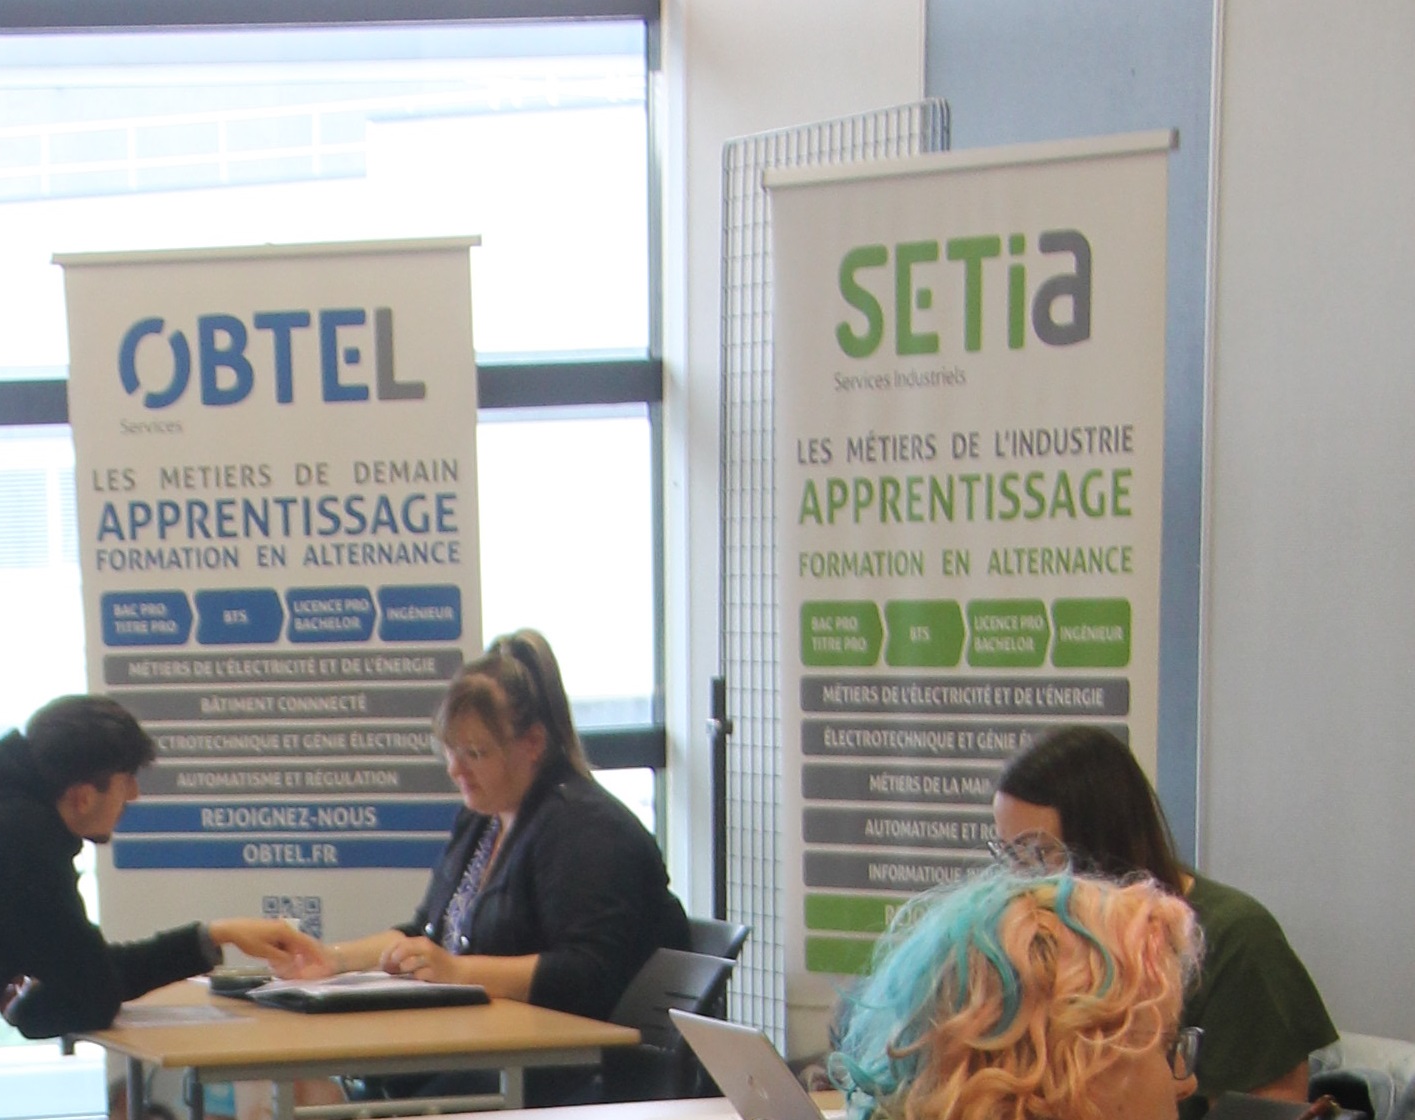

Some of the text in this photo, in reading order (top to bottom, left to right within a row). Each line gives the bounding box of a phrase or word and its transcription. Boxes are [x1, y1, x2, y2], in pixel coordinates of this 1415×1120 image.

[835, 228, 1092, 359] SETia
[118, 306, 427, 410] OBTEL
[834, 366, 967, 391] Services Industriels
[120, 418, 184, 436] Services
[797, 424, 1135, 466] LES MÉTIERS DE L'INDUSTRIE
[92, 468, 137, 493] LES
[295, 461, 330, 486] DE
[353, 457, 460, 485] DEMAIN
[797, 467, 1134, 526] APPRENTISSAGE
[96, 492, 460, 542] APPRENTISSAGE
[96, 539, 462, 572] FORMATION EN ALTERNANCE
[798, 545, 1134, 578] FORMATION EN ALTERNANCE
[140, 602, 168, 618] PRO
[293, 598, 370, 614] LICENCE PRO
[388, 605, 454, 621] INGÉNIEUR
[150, 619, 178, 634] PRO
[223, 610, 248, 624] BTS
[294, 616, 361, 631] BACHELOR
[811, 616, 859, 632] BAC PRO
[974, 614, 1044, 632] LICENCE PRO
[909, 626, 931, 642] BTS
[974, 635, 1035, 653] BACHELOR
[1060, 624, 1125, 643] INGÉNIEUR
[811, 636, 868, 653] TITRE PRO
[192, 661, 214, 676] DE
[216, 656, 318, 676] L'ÉLECTRICITÉ
[321, 659, 340, 673] ET
[343, 658, 362, 673] DE
[366, 655, 436, 673] L'ÉNERGIE
[822, 682, 1104, 704] MÉTIERS DE L'ÉLECTRICITÉ ET DE L'ÉNERGIE
[201, 694, 275, 714] BÂTIMENT
[283, 734, 301, 749] ET
[303, 730, 347, 749] GÉNIE
[350, 729, 434, 751] ÉLECTRIQU
[824, 728, 955, 752] ÉLECTROTECHNIQUE
[959, 732, 975, 749] ET
[977, 729, 1017, 750] GÉNIE
[176, 767, 399, 788] AUTOMATISME ET RÉGULATION
[869, 772, 921, 792] MÉTIERS
[924, 776, 941, 793] DE
[942, 777, 959, 794] LA
[201, 806, 377, 828] REJOIGNEZ-NOUS
[865, 818, 959, 840] AUTOMATISME
[961, 823, 978, 840] ET
[243, 844, 339, 865] OBTEL.FR
[868, 862, 961, 885] INFORMATIQUE
